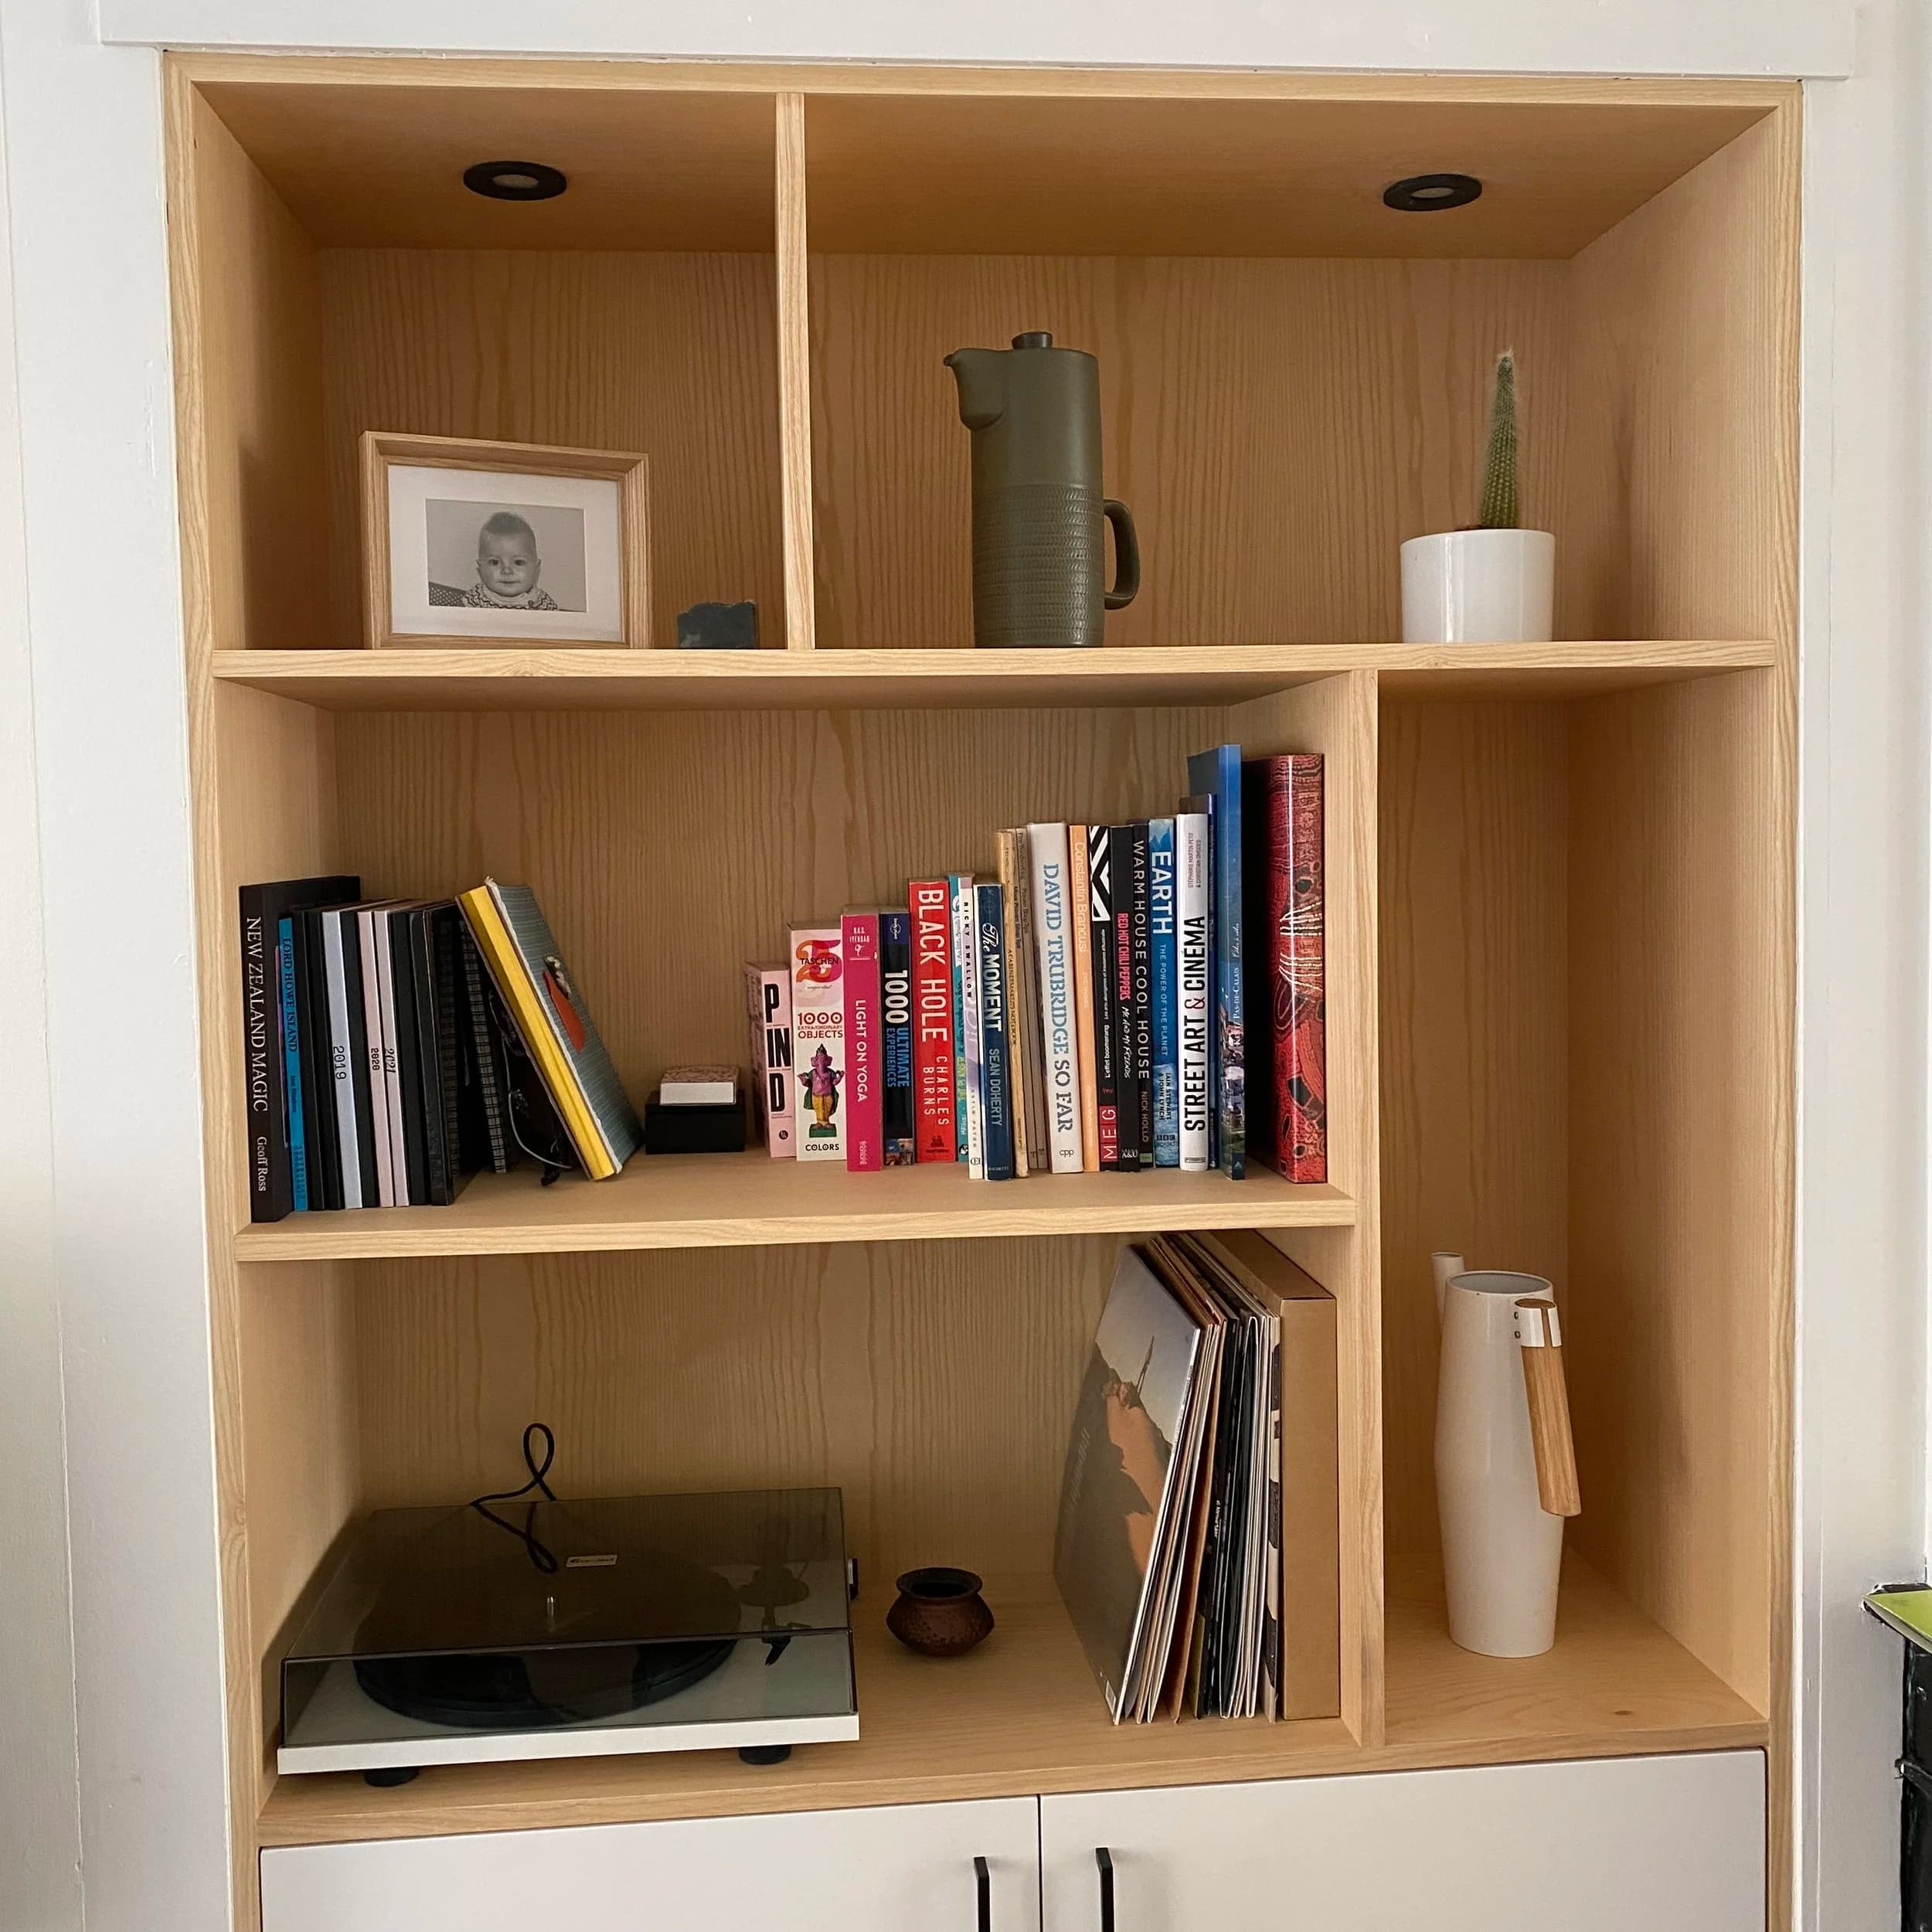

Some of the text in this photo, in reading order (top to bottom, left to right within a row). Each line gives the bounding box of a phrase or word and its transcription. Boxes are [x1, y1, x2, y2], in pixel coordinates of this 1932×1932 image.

[1151, 852, 1172, 934] EARTH
[1077, 903, 1089, 952] Brancusi
[1117, 913, 1131, 1001] RED HOT CHILI PEPPERS
[1184, 916, 1205, 991] CINEMA
[918, 889, 947, 1043] BLACK HOLE
[982, 923, 1002, 1032] The MOMENT
[1133, 841, 1149, 1079] WARM HOUSE COOL HOUSE
[247, 917, 268, 1112] NEW ZEALAND MAGIC
[283, 937, 298, 1052] LORD HOWE ISLAND
[798, 1012, 843, 1026] 1000
[885, 970, 909, 1024] 1000
[1044, 864, 1073, 1132] DAVID TRUBRIDGE SO FAR
[1161, 993, 1167, 1004] OF
[1184, 996, 1206, 1010] &
[333, 1046, 347, 1080] 2019
[371, 1047, 380, 1070] 2020
[386, 1049, 396, 1073] 2021
[798, 1030, 844, 1039] OBJECTS
[855, 1000, 868, 1102] LIGHT ON YOGA
[886, 1028, 896, 1087] EXPERIENCES
[896, 1027, 910, 1087] ULTIMATE
[1184, 1015, 1206, 1053] ART
[923, 1067, 935, 1115] BURNS
[936, 1056, 949, 1125] CHARLES
[989, 1049, 1002, 1125] SEAN DOHERTY
[1184, 1058, 1206, 1131] STREET
[1102, 1109, 1117, 1158] MEG
[257, 1136, 268, 1191] Geoff Ross
